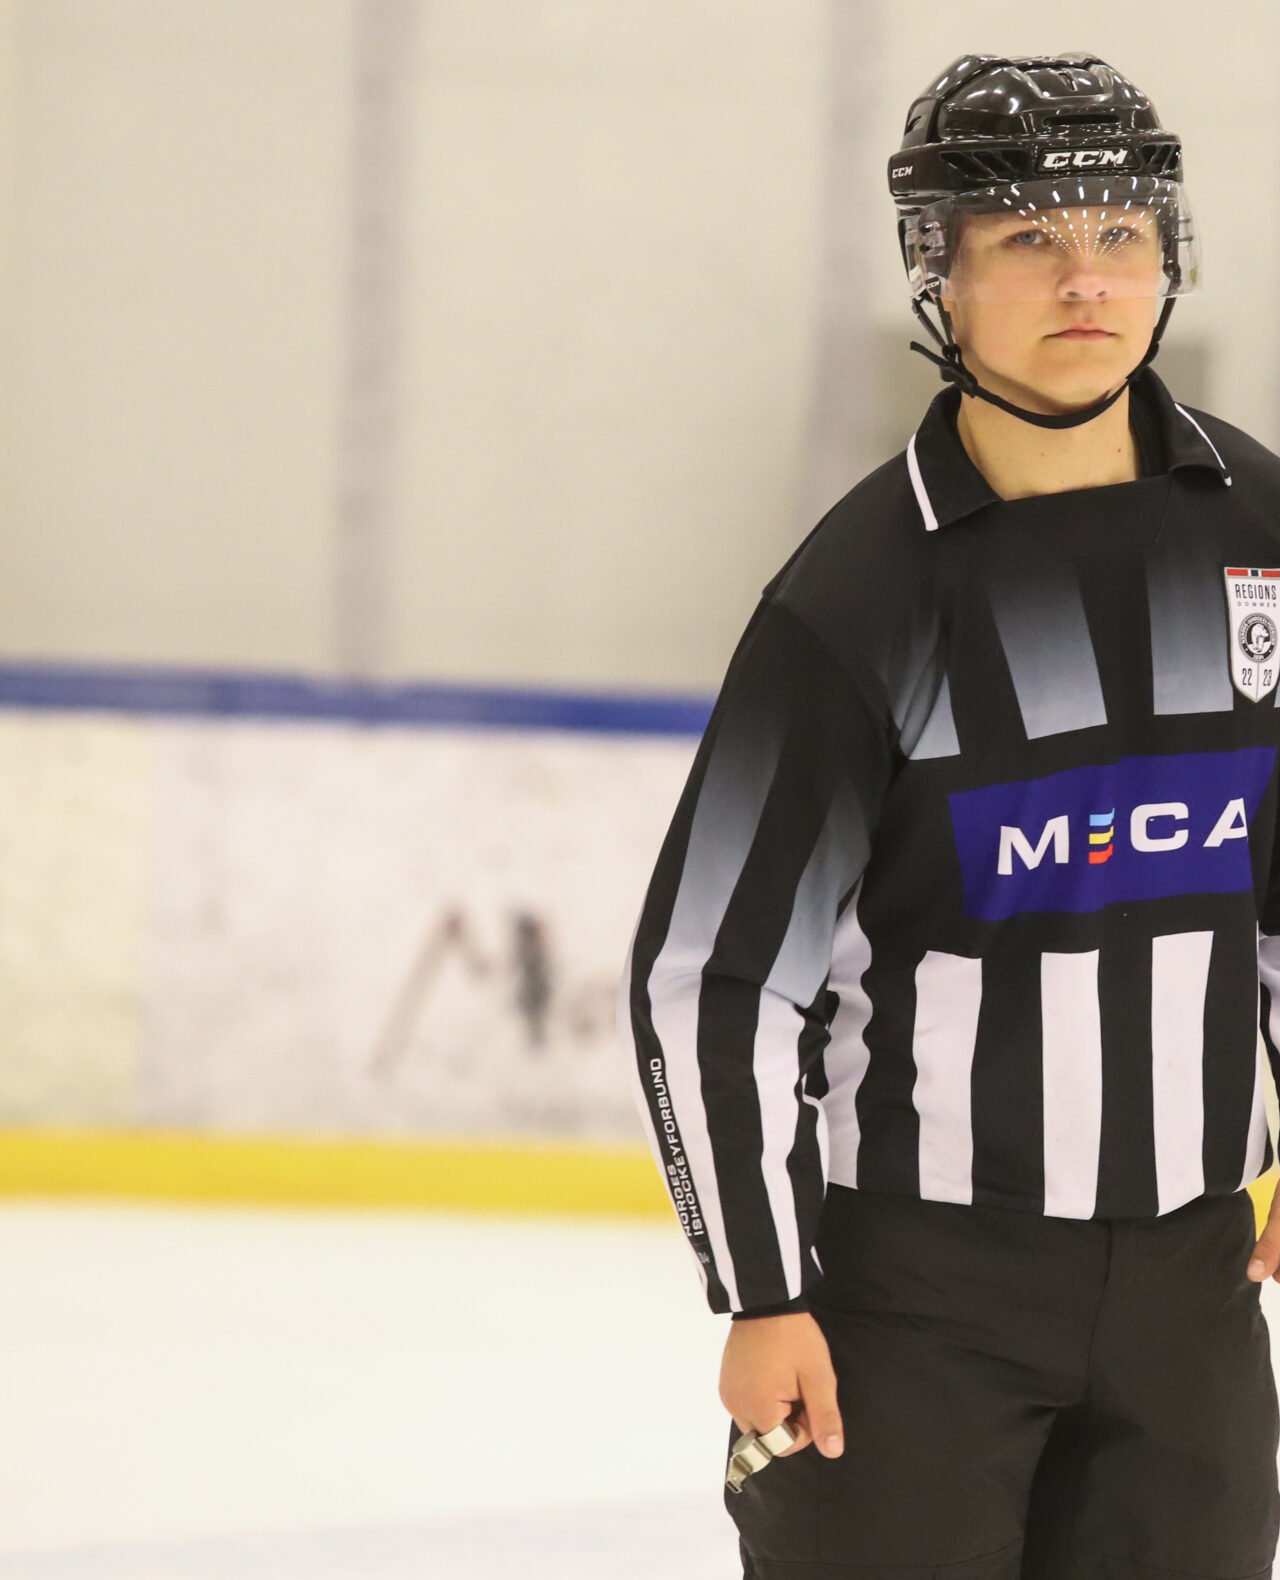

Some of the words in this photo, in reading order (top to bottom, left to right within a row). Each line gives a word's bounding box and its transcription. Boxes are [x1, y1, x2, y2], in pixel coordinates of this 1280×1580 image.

[1043, 148, 1129, 170] CCM
[891, 165, 913, 179] CCM
[1235, 583, 1277, 600] REGIONS
[1241, 667, 1253, 686] 22
[1262, 668, 1273, 687] 23
[997, 797, 1249, 876] MECA
[649, 1057, 705, 1236] ISHOCKEYFORBUND
[666, 1164, 693, 1237] NORGES
